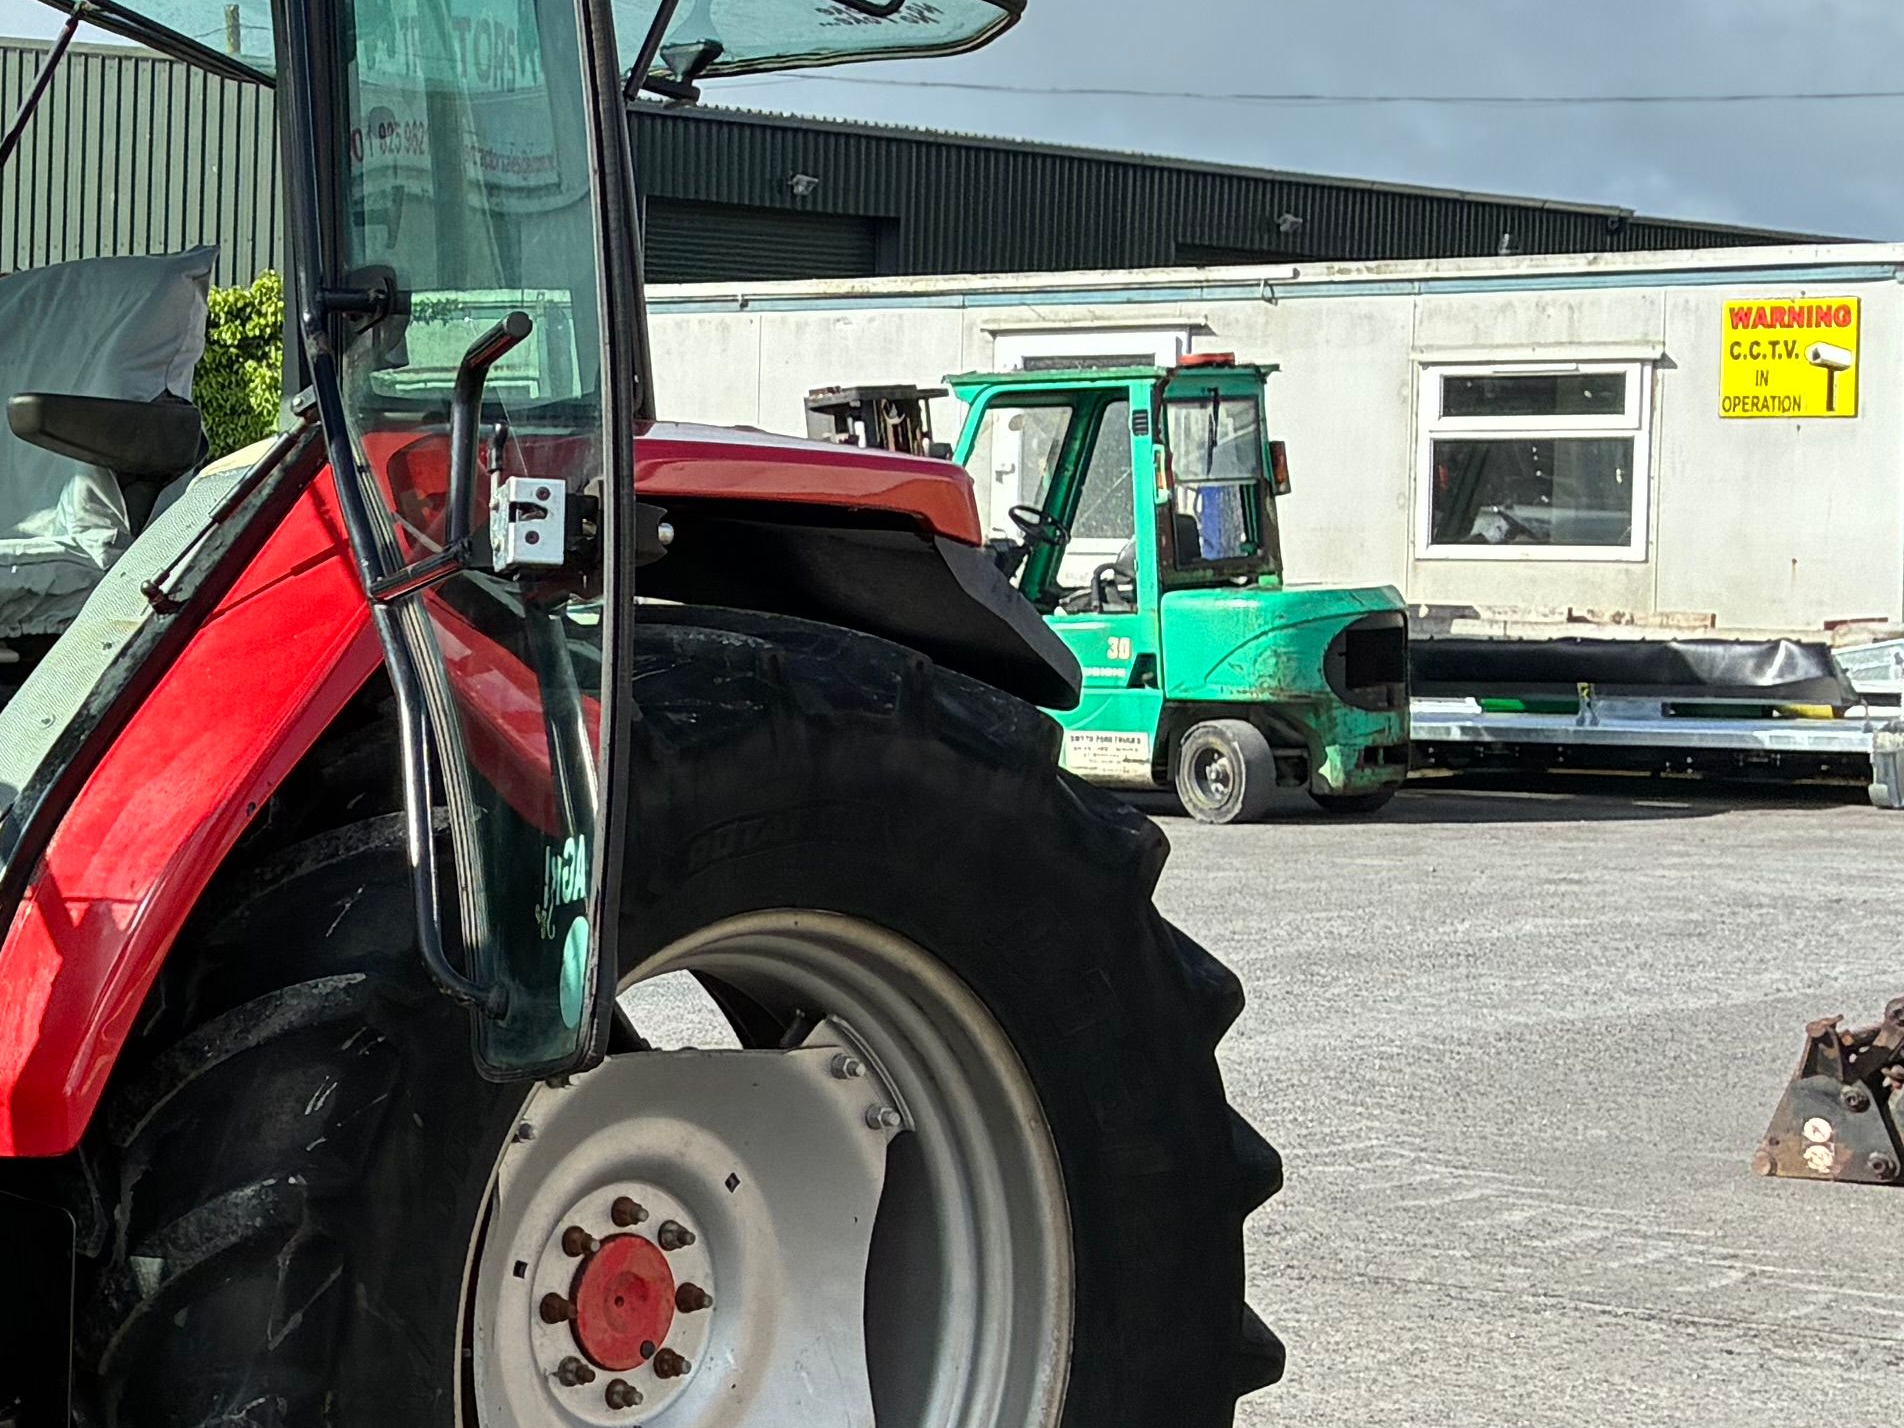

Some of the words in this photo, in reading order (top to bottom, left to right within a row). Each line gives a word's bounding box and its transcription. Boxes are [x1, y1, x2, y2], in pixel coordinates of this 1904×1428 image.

[1729, 304, 1852, 330] WARNING
[1730, 339, 1800, 360] C.C.T.V.
[1755, 369, 1769, 387] IN
[1722, 395, 1802, 413] OPERATION
[1106, 636, 1132, 661] 30
